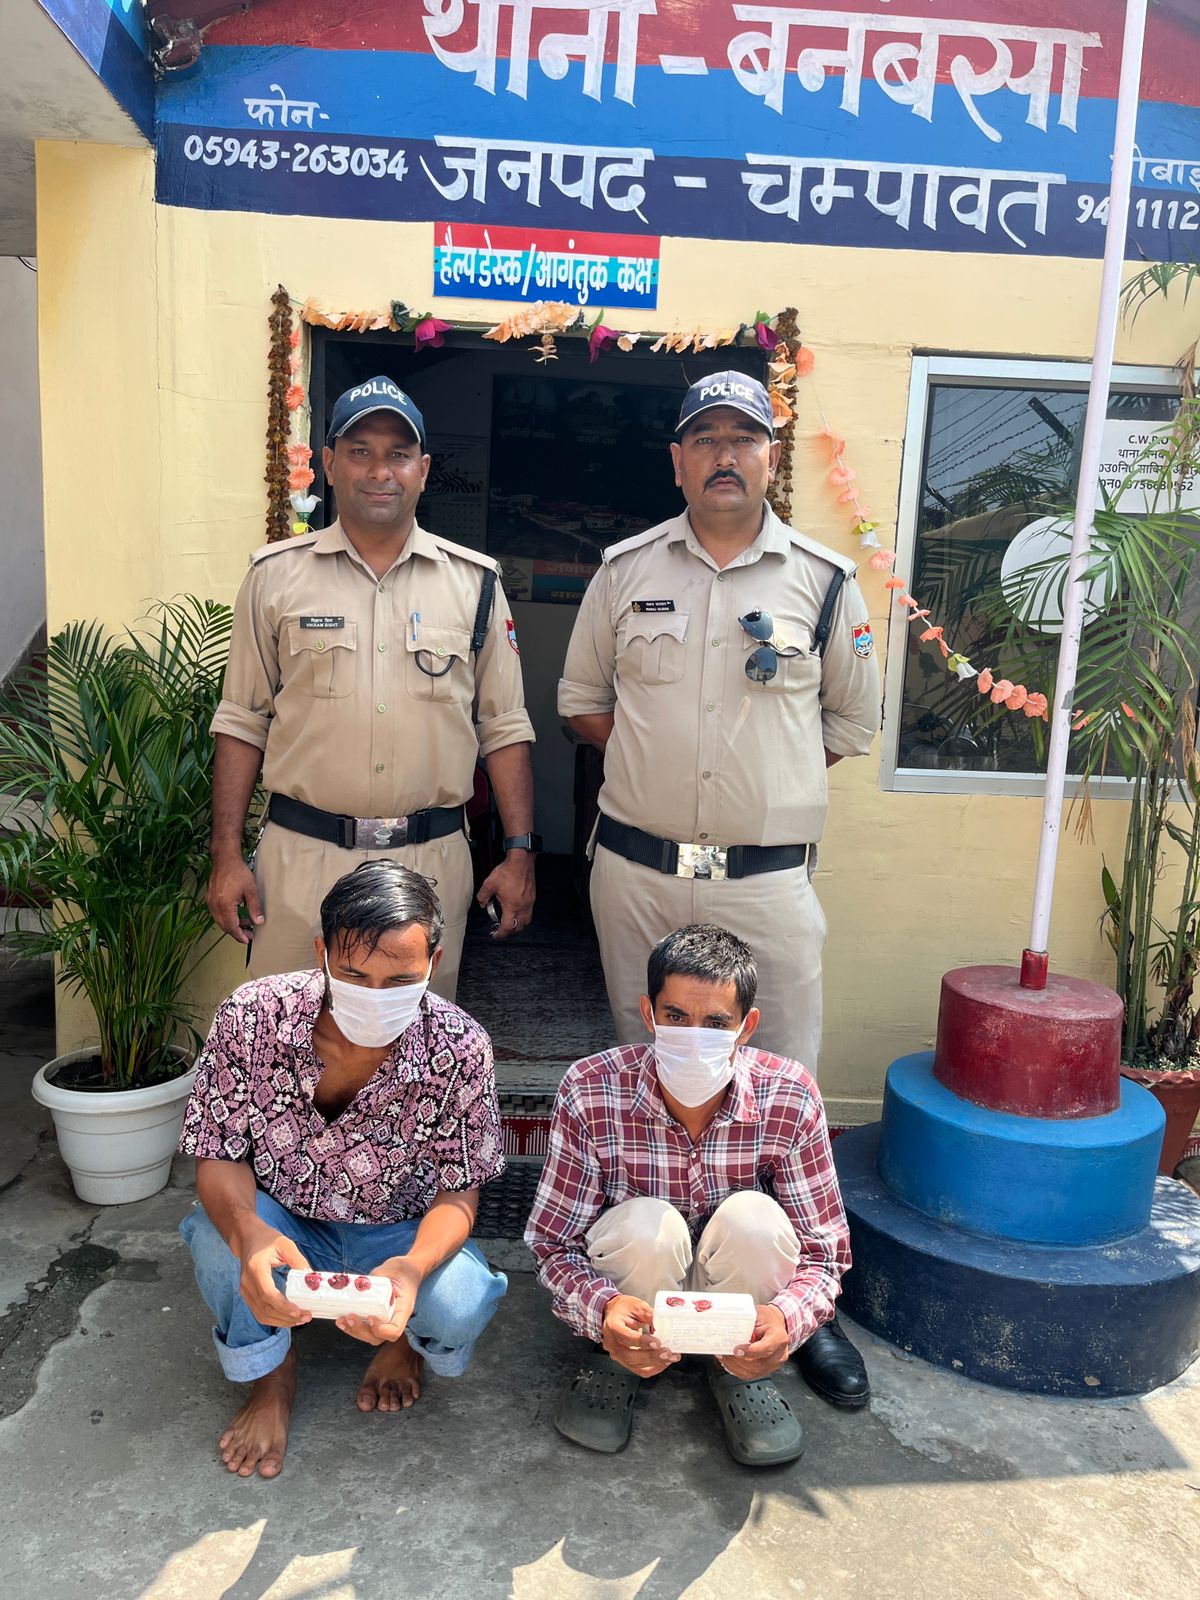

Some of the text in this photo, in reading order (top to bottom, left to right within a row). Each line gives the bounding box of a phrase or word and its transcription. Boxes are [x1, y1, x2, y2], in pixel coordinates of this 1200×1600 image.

[421, 0, 657, 109] थाना
[183, 134, 409, 182] 05943-263034
[418, 135, 656, 225] जनपद
[740, 152, 1067, 249] चम्पावत
[617, 255, 654, 295] कक्ष
[350, 381, 408, 406] POLICE
[700, 382, 756, 402] POLICE
